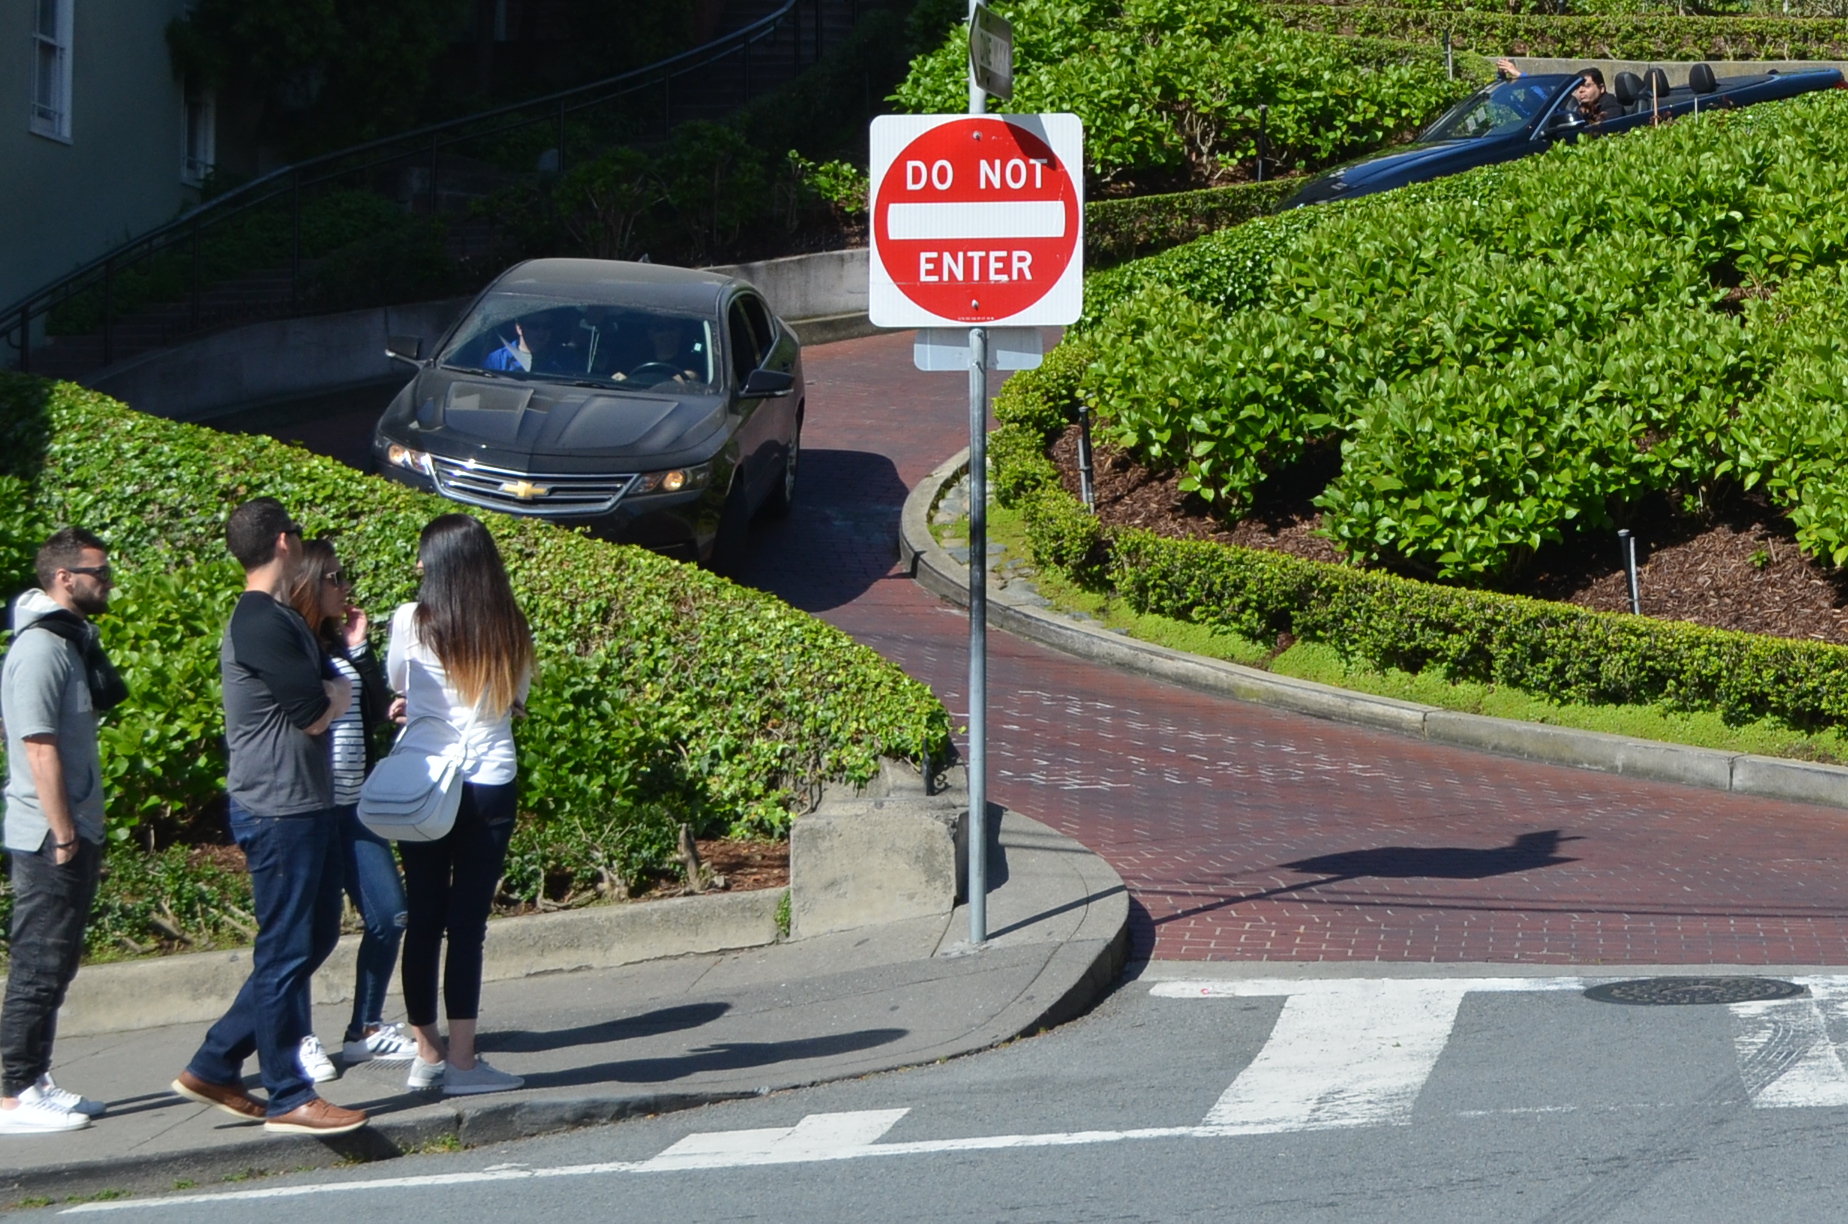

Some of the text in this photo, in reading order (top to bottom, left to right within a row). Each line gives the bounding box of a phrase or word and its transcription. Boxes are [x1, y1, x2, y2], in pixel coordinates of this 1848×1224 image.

[906, 158, 1048, 191] DO NOT
[919, 250, 1033, 282] ENTER
